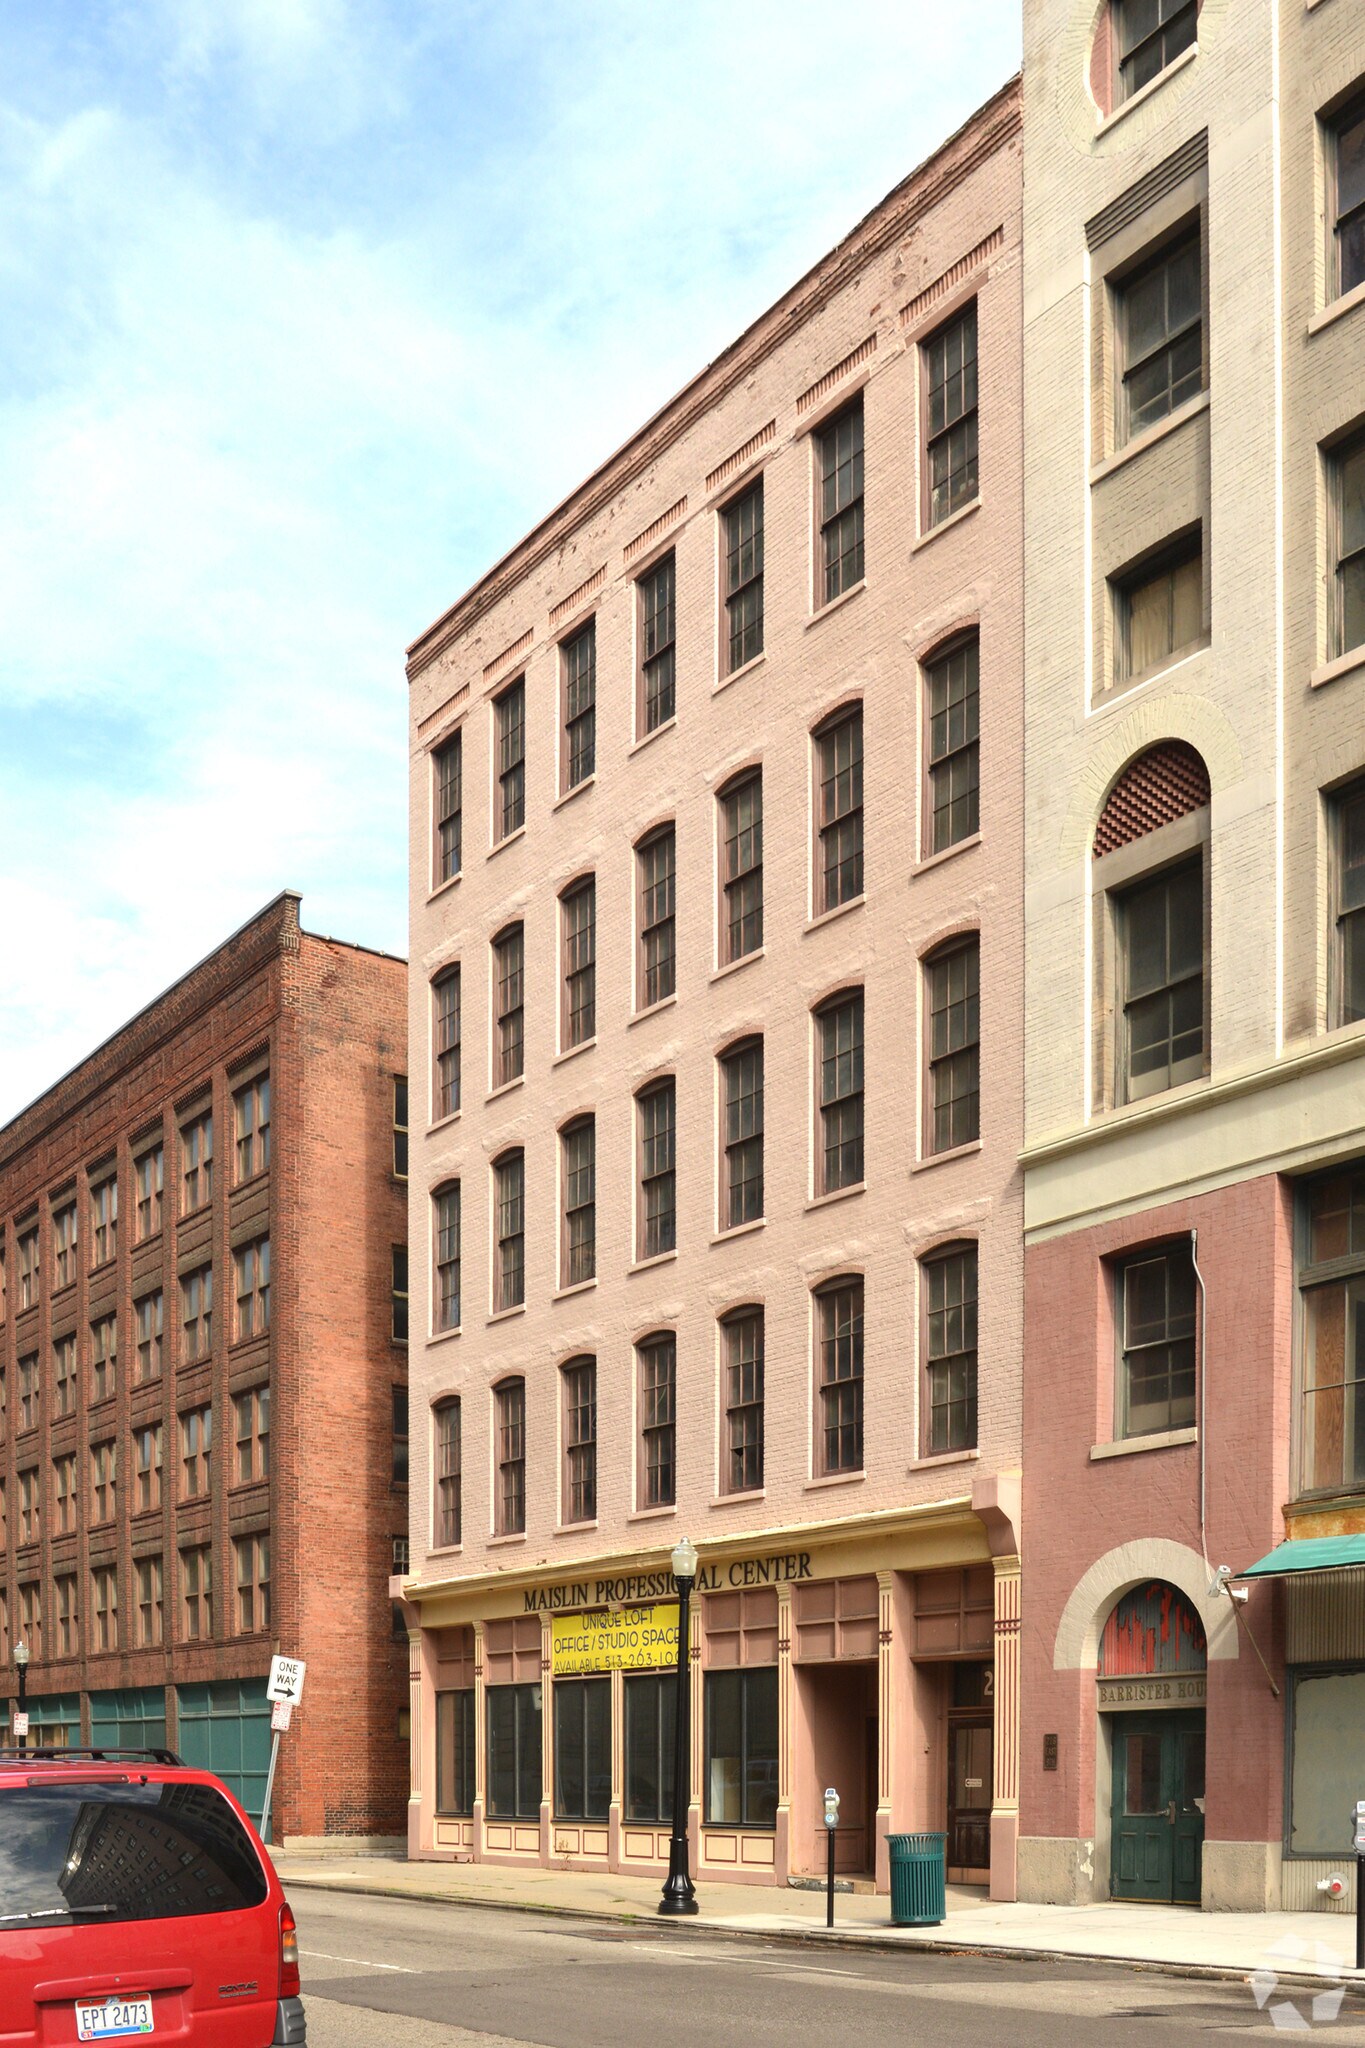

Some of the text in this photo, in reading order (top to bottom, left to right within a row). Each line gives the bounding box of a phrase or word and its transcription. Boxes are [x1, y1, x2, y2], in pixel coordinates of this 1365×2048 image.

[524, 1552, 813, 1612] MAISLIN PROFESSIOAL CENTER
[582, 1607, 655, 1631] UNIQUE LOFT
[553, 1635, 590, 1655] OFFICE
[598, 1630, 639, 1651] STUDIO
[642, 1626, 680, 1647] SPACE
[279, 1661, 298, 1674] ONE
[554, 1657, 600, 1674] AVAILABLE
[276, 1674, 297, 1686] WAY
[1100, 1683, 1172, 1703] BARRISTER
[82, 2004, 148, 2031] EPT 2473
